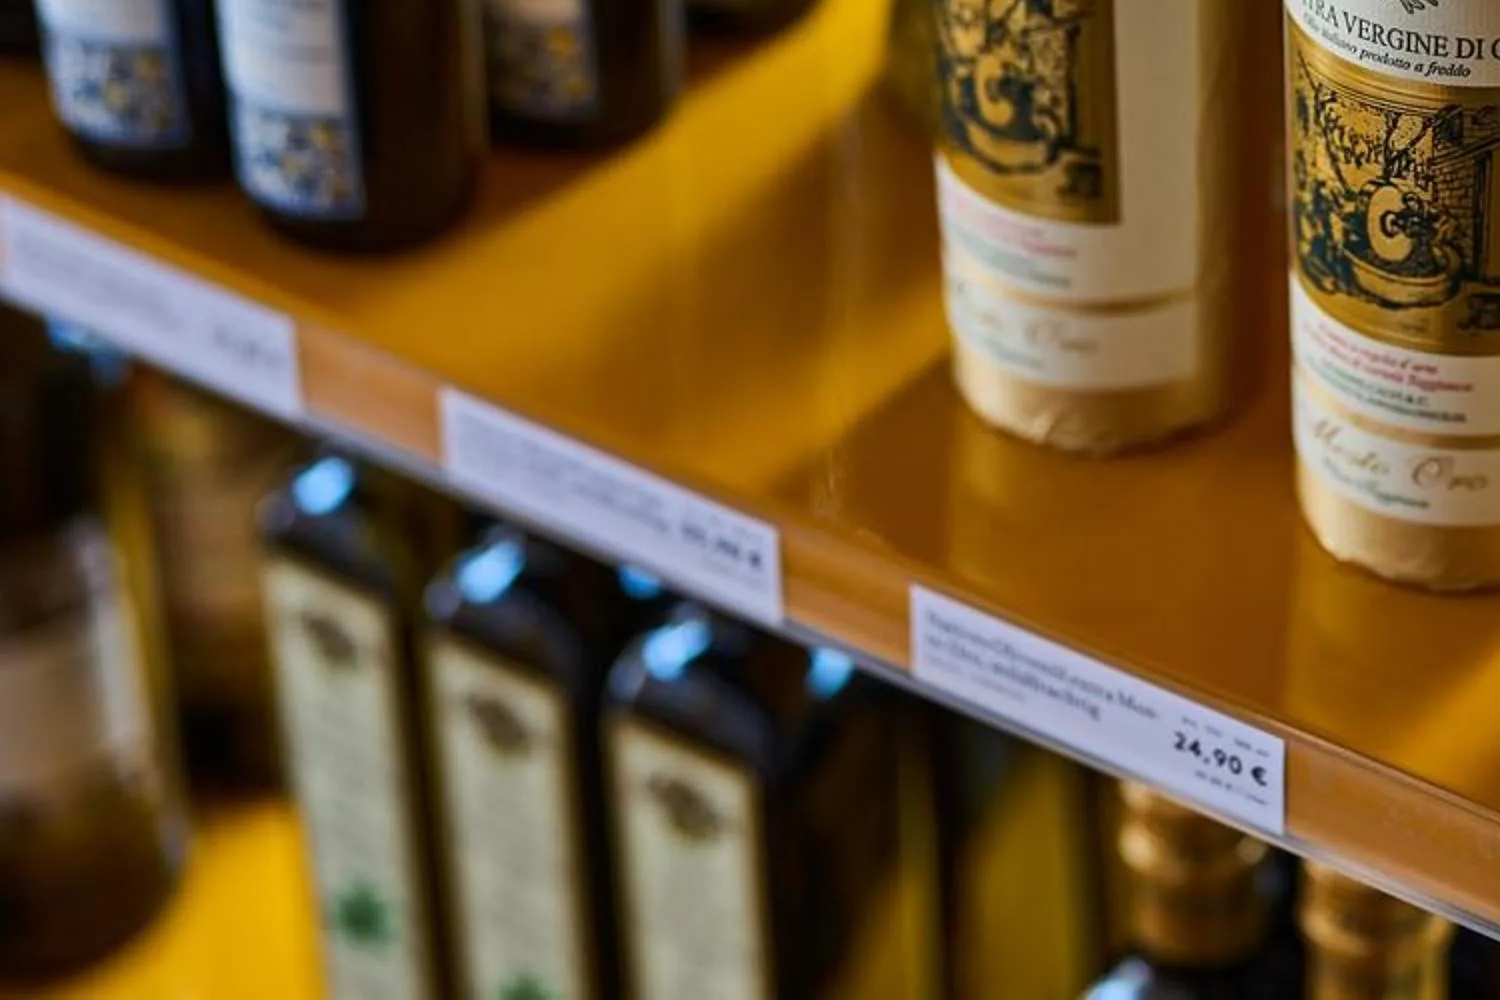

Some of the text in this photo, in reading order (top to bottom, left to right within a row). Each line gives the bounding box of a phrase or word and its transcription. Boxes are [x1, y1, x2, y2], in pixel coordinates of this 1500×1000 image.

[1341, 11, 1449, 58] VERGINE
[1455, 38, 1485, 61] DI
[1360, 49, 1410, 71] prodotto
[1414, 63, 1423, 73] a
[1423, 61, 1471, 78] freddo
[1173, 730, 1243, 777] 24,90
[1250, 764, 1268, 788] €
